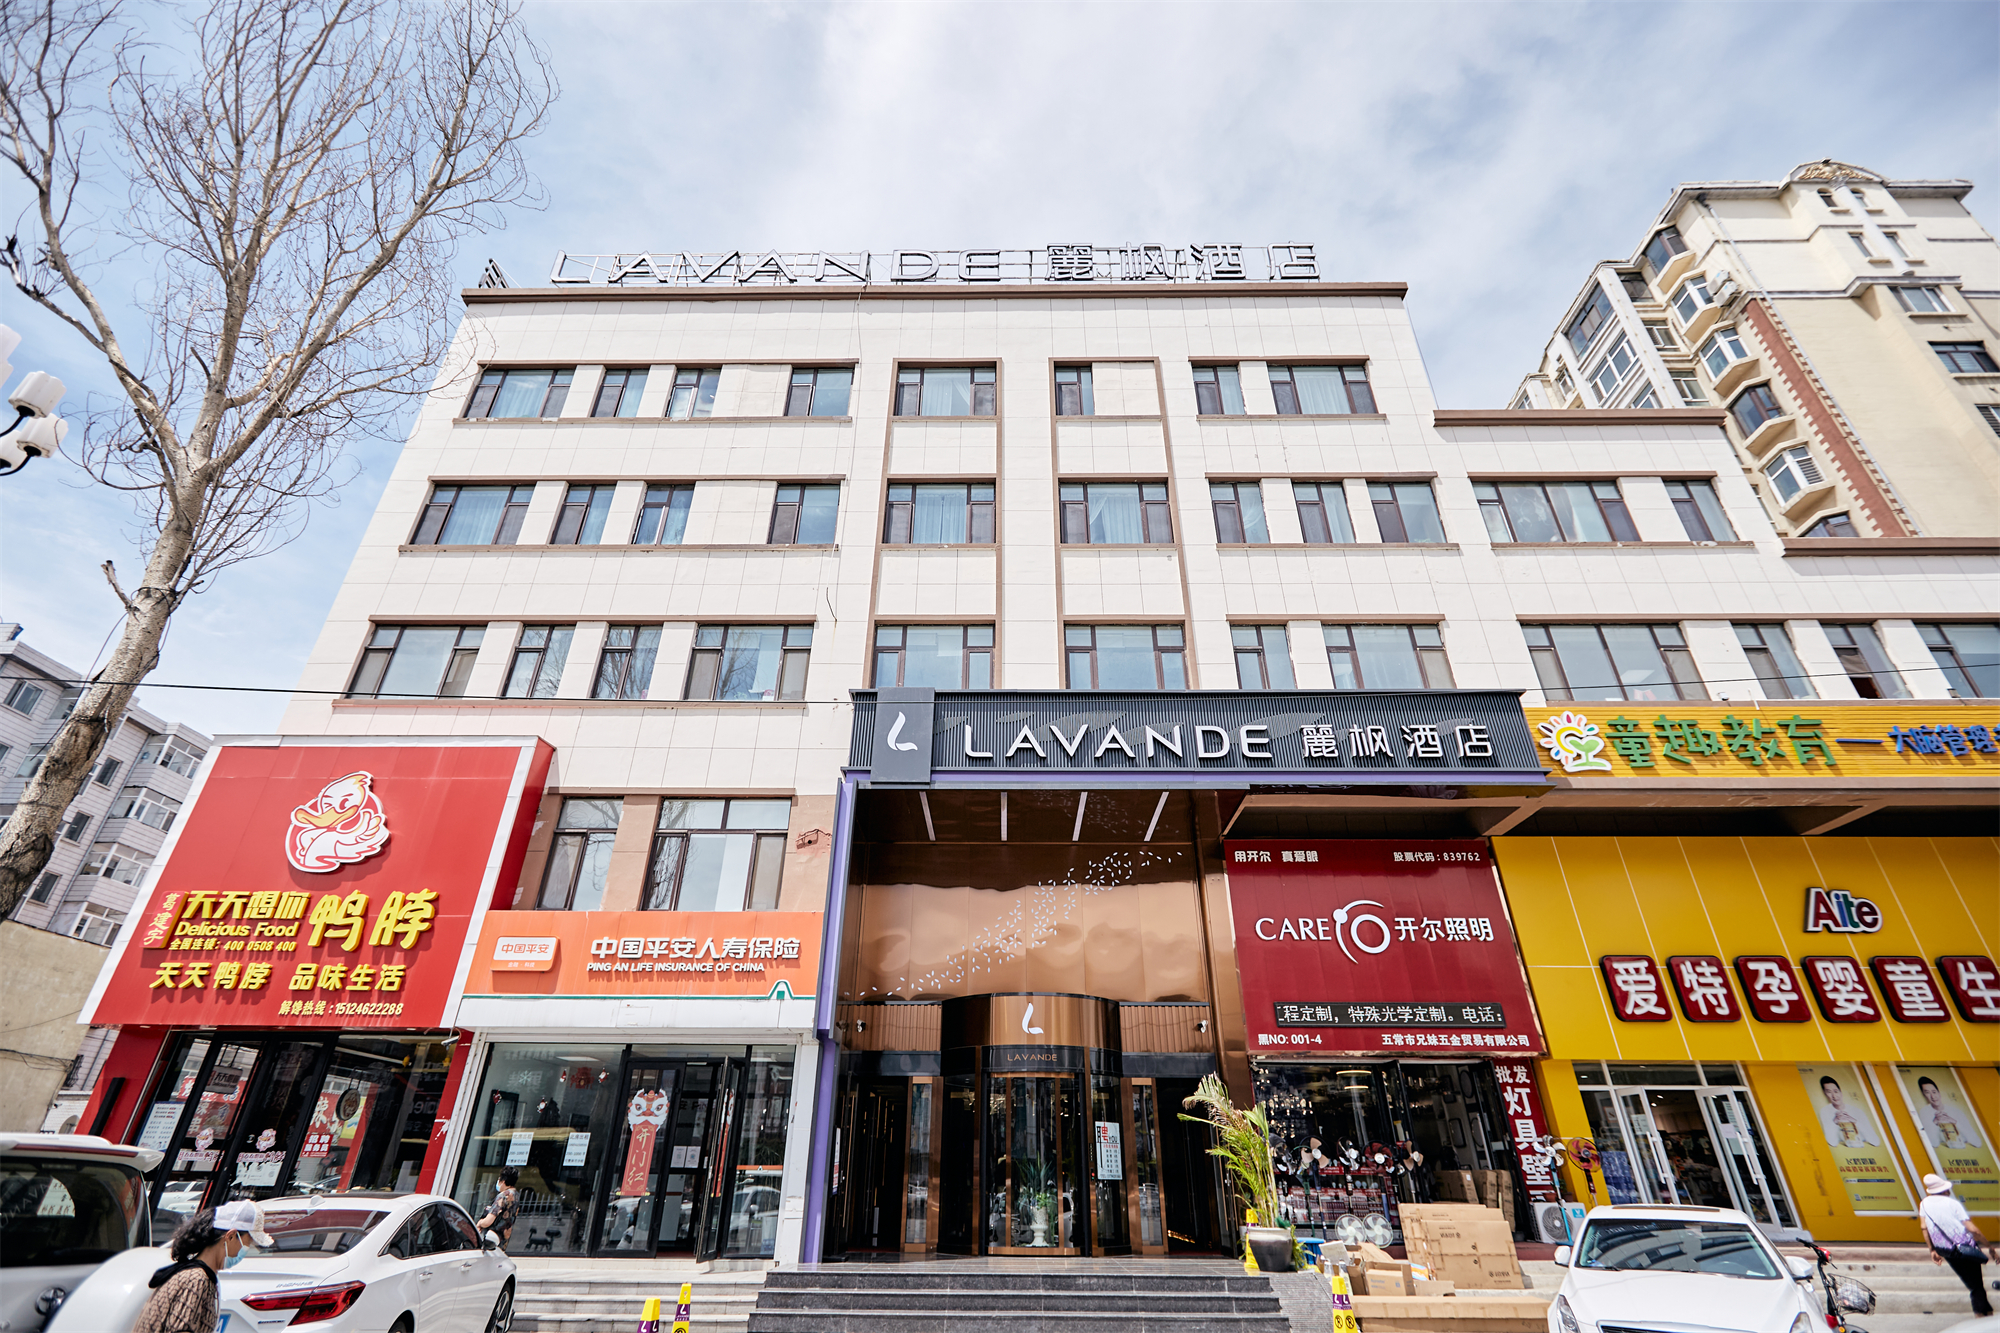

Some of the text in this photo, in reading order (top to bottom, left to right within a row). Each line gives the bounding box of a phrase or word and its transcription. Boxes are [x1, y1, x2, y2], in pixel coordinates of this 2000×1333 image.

[549, 249, 1000, 283] LAVANDE
[965, 724, 1274, 759] LAVANDE
[1605, 715, 1838, 768] 童趣教育
[1234, 851, 1319, 863] 用开尔 真爱眼
[308, 887, 440, 952] 鸭脖
[1808, 888, 1882, 933] Aite
[174, 921, 300, 938] Delicious Food
[1394, 917, 1496, 943] 开尔照明
[223, 940, 245, 952] 400
[247, 940, 274, 952] 0508
[275, 941, 297, 953] 400
[501, 943, 550, 954] 中国平安
[590, 937, 801, 960] 中国平安人寿保险
[149, 961, 407, 991] 天天鸭脖 品味生活
[586, 962, 765, 973] PING AN LIFE INSURANCE OF CHINA
[1291, 1034, 1322, 1045] 001-4
[1382, 1034, 1530, 1047] 五常市兄妹五金贸易有限公司
[1007, 1053, 1058, 1061] LAVANDE
[1495, 1065, 1531, 1084] 批发
[627, 1128, 651, 1185] 开门红
